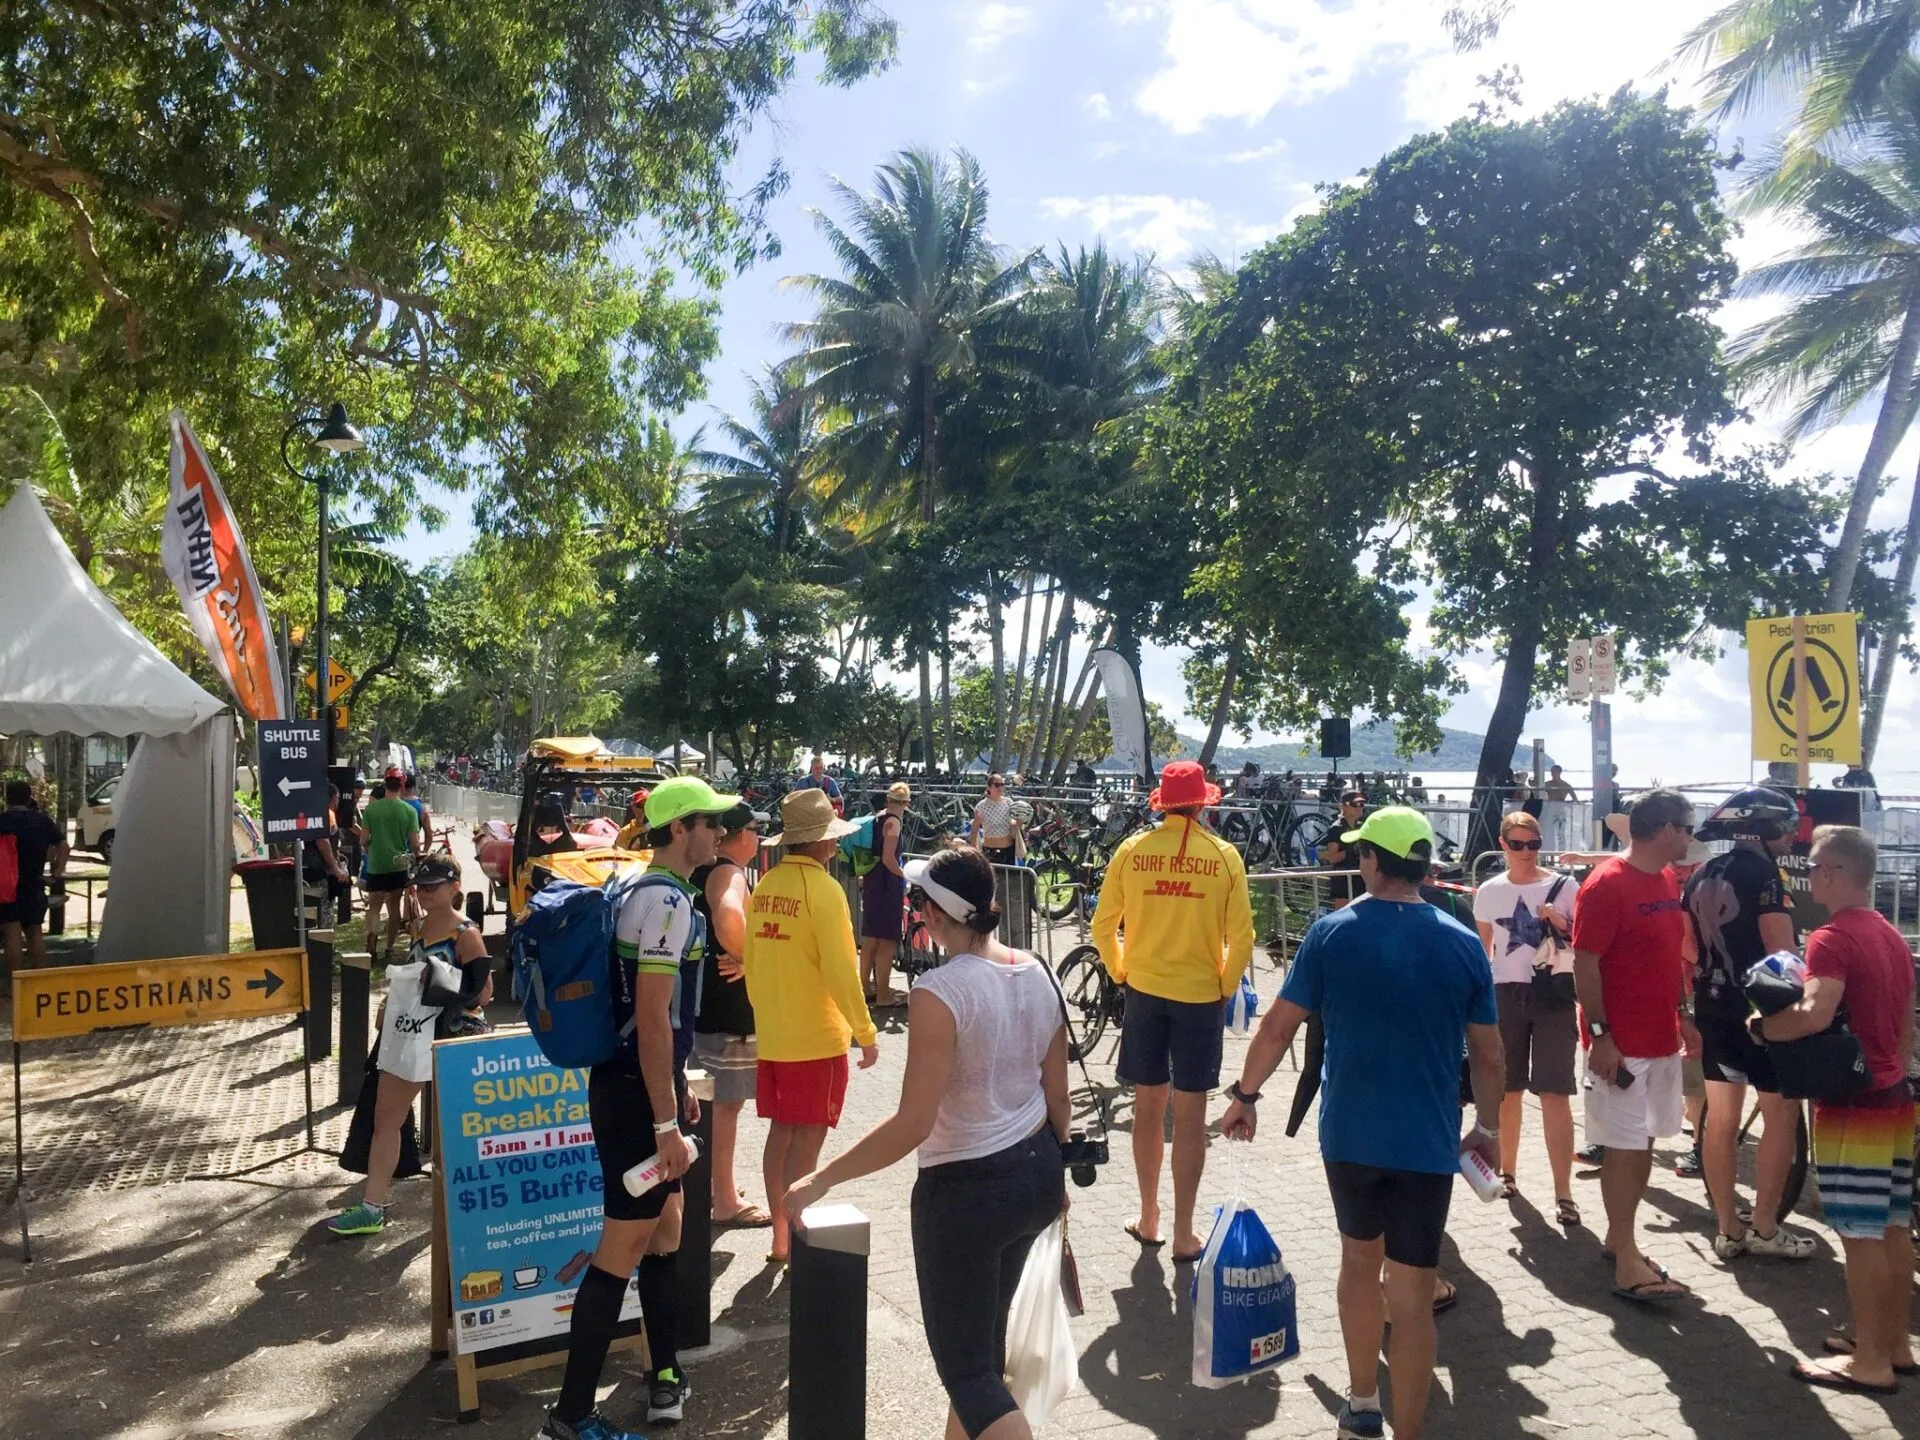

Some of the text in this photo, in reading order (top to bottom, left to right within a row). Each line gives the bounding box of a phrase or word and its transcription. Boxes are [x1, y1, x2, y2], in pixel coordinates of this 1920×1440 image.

[1769, 621, 1835, 638] Pedtrian
[329, 675, 346, 687] IP
[264, 729, 321, 742] SHUTTLE
[281, 747, 308, 759] BUS
[1780, 743, 1834, 761] Crsing
[1133, 854, 1220, 877] SURF RESCUE
[1155, 880, 1191, 897] DHL
[772, 896, 802, 918] RSCUE
[36, 975, 231, 1018] PEDESTRIANS
[472, 1054, 521, 1077] Join
[473, 1067, 591, 1105] SUNDAY
[481, 1139, 527, 1156] 5am
[452, 1163, 491, 1185] ALL
[496, 1156, 537, 1177] YOU
[542, 1148, 586, 1169] CAN
[458, 1183, 508, 1213] $15
[520, 1169, 604, 1204] Buffe
[486, 1215, 542, 1236] Including
[486, 1221, 604, 1250] tea, coffee and juic
[1223, 1290, 1255, 1307] BIKE
[1263, 1332, 1284, 1355] 1589
